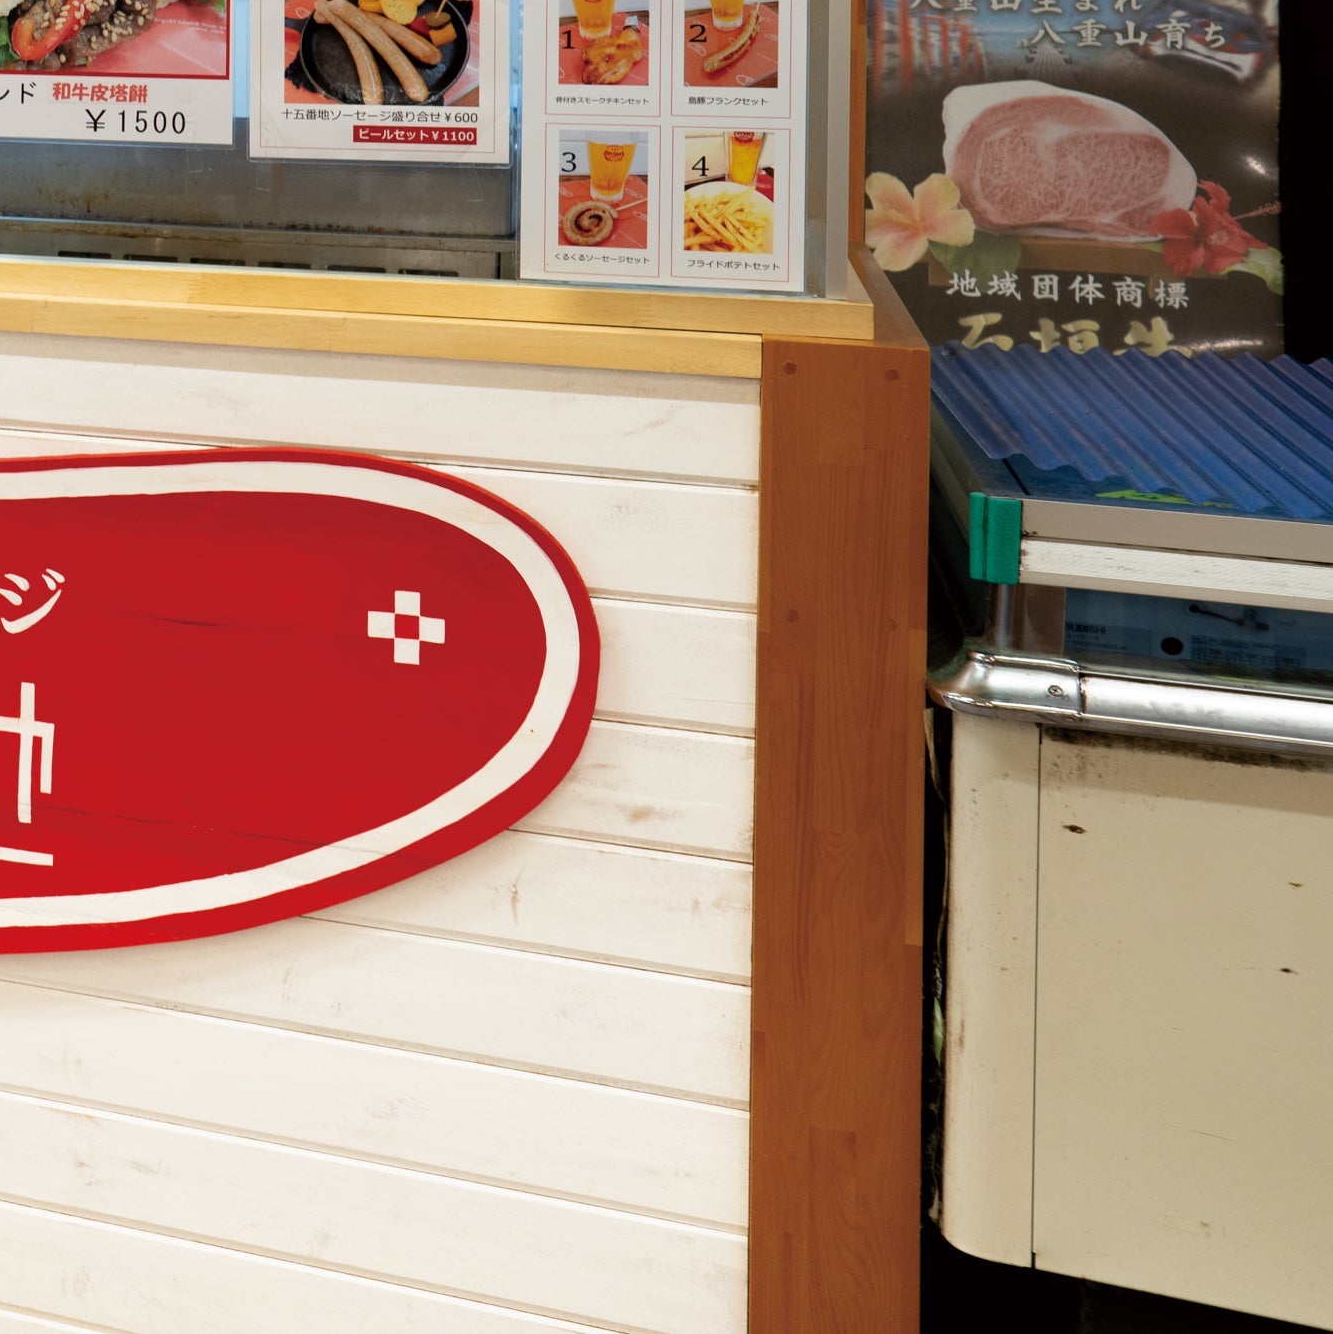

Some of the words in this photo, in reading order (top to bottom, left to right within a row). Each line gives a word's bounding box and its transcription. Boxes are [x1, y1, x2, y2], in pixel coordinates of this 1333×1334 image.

[561, 30, 576, 50] 1
[689, 24, 707, 43] 2
[1031, 19, 1228, 50] 八重山育ち
[85, 107, 187, 135] ¥1500
[561, 151, 577, 173] 3
[691, 156, 709, 177] 4
[687, 258, 780, 272] フライドポテトセット
[946, 271, 1190, 309] 地域団体商標
